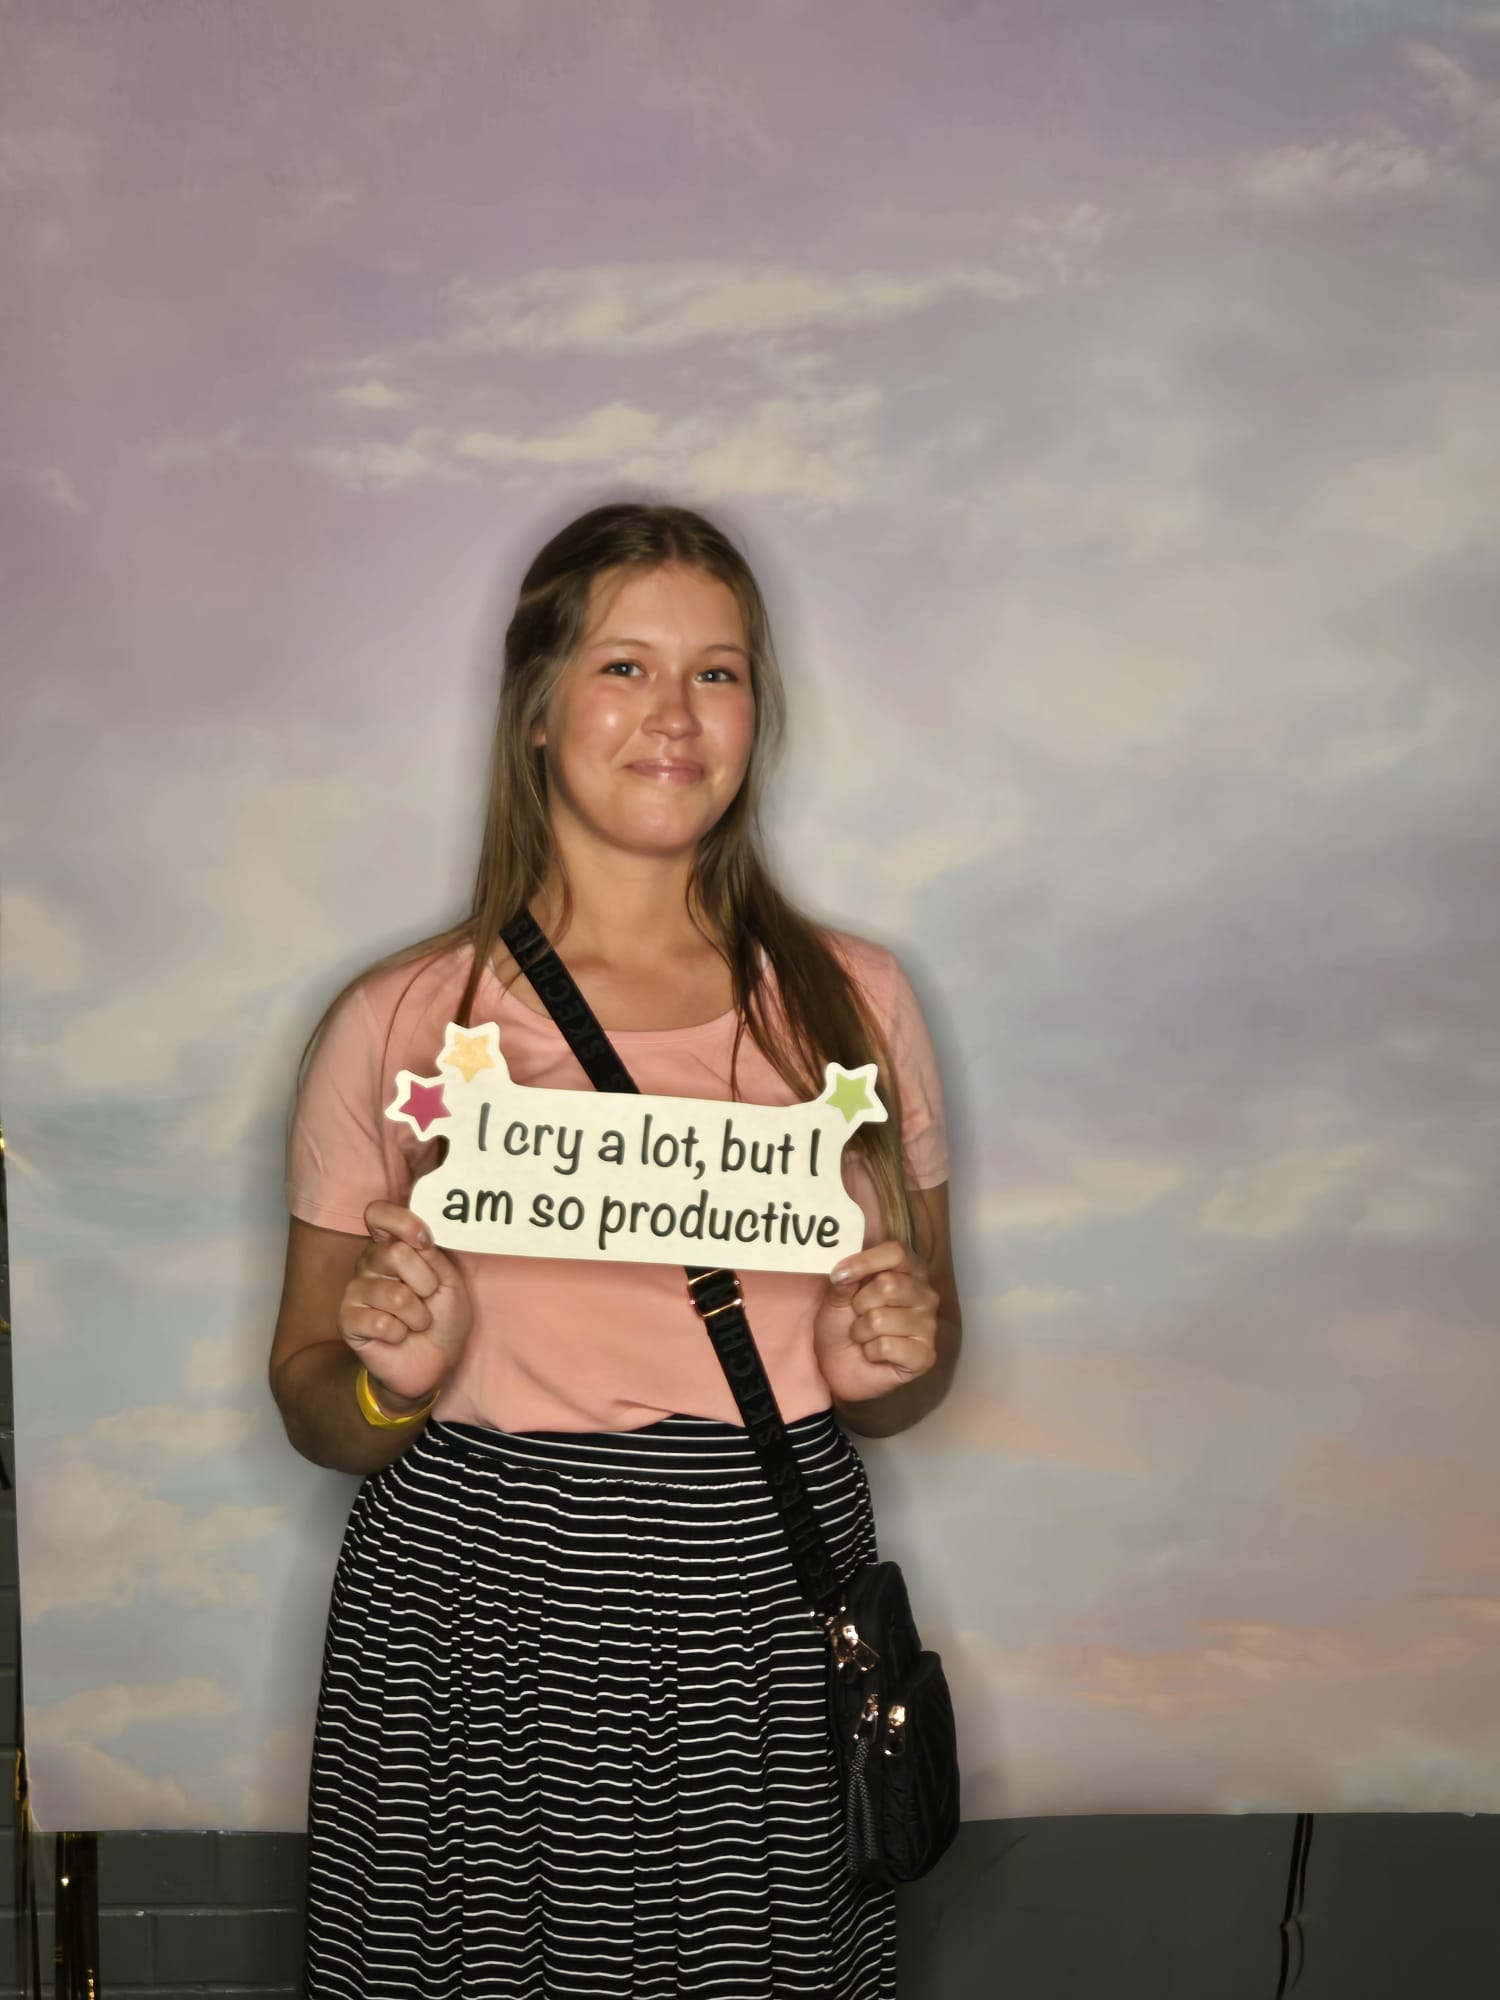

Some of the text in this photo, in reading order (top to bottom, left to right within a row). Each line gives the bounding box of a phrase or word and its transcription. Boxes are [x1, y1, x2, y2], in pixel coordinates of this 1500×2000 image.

[479, 1103, 821, 1181] I cry a lot, but I
[442, 1188, 840, 1251] am so productive
[698, 1284, 781, 1447] SKECHER
